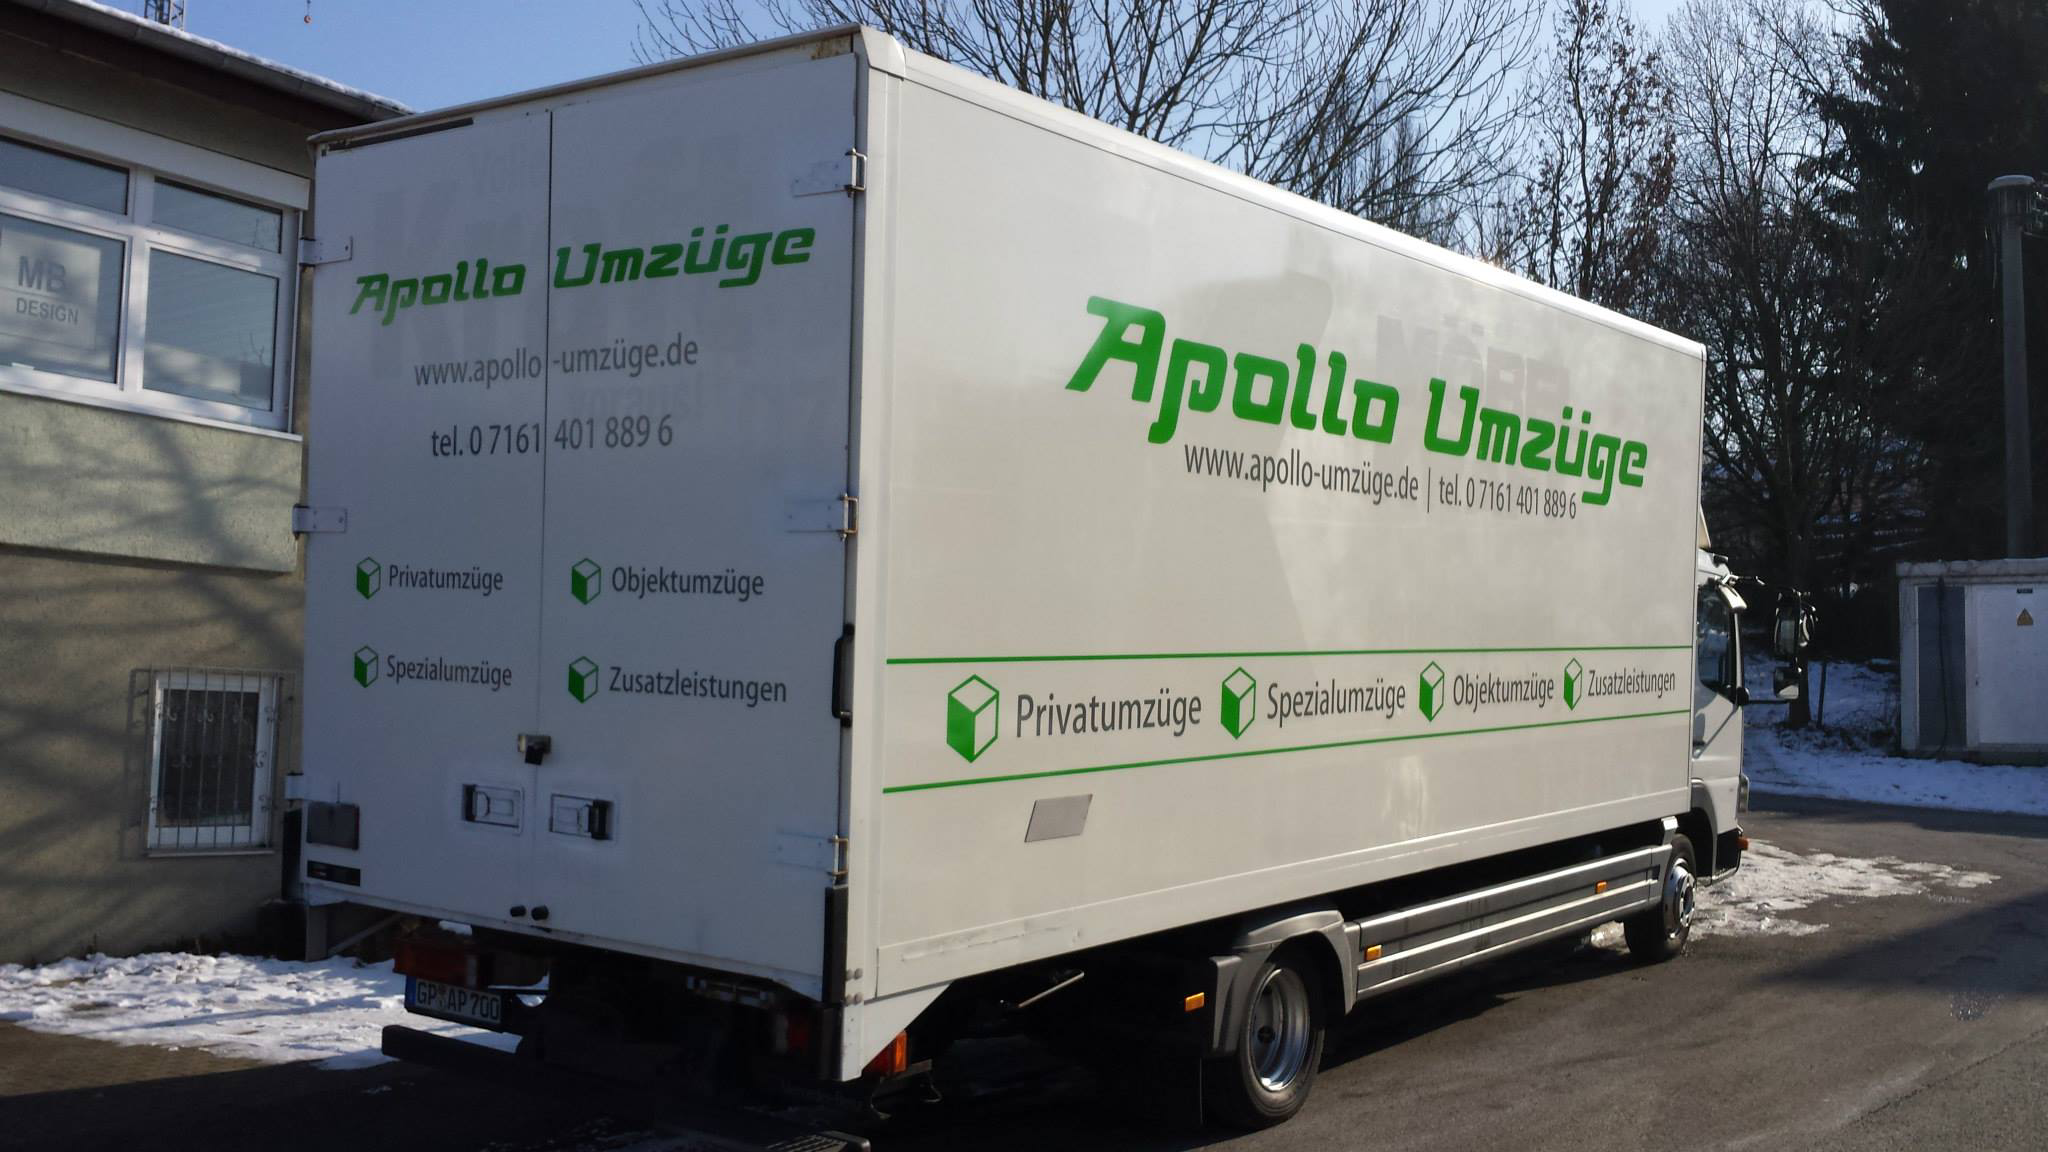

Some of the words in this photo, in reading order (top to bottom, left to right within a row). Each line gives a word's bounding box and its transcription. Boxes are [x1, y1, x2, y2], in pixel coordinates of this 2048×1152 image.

[18, 255, 66, 293] MB
[349, 257, 527, 326] Apollo
[554, 224, 815, 289] Umzüge
[16, 297, 79, 325] DESIGN
[1065, 296, 1400, 444] Apollo
[1424, 377, 1648, 506] Umzüge
[431, 424, 463, 457] tel.
[469, 425, 482, 456] 0
[489, 423, 541, 454] 7161
[554, 418, 594, 450] 401
[605, 415, 650, 448] 889
[658, 414, 673, 447] 6
[1184, 443, 1418, 506] www.apollo-umzüge.de
[1439, 473, 1462, 507] tel.
[1479, 479, 1512, 513] 7161
[1516, 485, 1539, 516] 401
[389, 564, 504, 592] Privatumzüge
[611, 566, 765, 602] Objektumzüge
[386, 654, 513, 692] Spezialumzüge
[608, 666, 787, 708] Zusatzleistungen
[1016, 688, 1202, 738] Privatumzüge
[1267, 678, 1406, 728] Spezialumzüge
[1453, 671, 1554, 712] Objektumzüge
[1588, 667, 1676, 700] Zusatzleistungen
[417, 981, 437, 1006] GP
[447, 988, 467, 1013] AP
[470, 993, 500, 1020] 700
